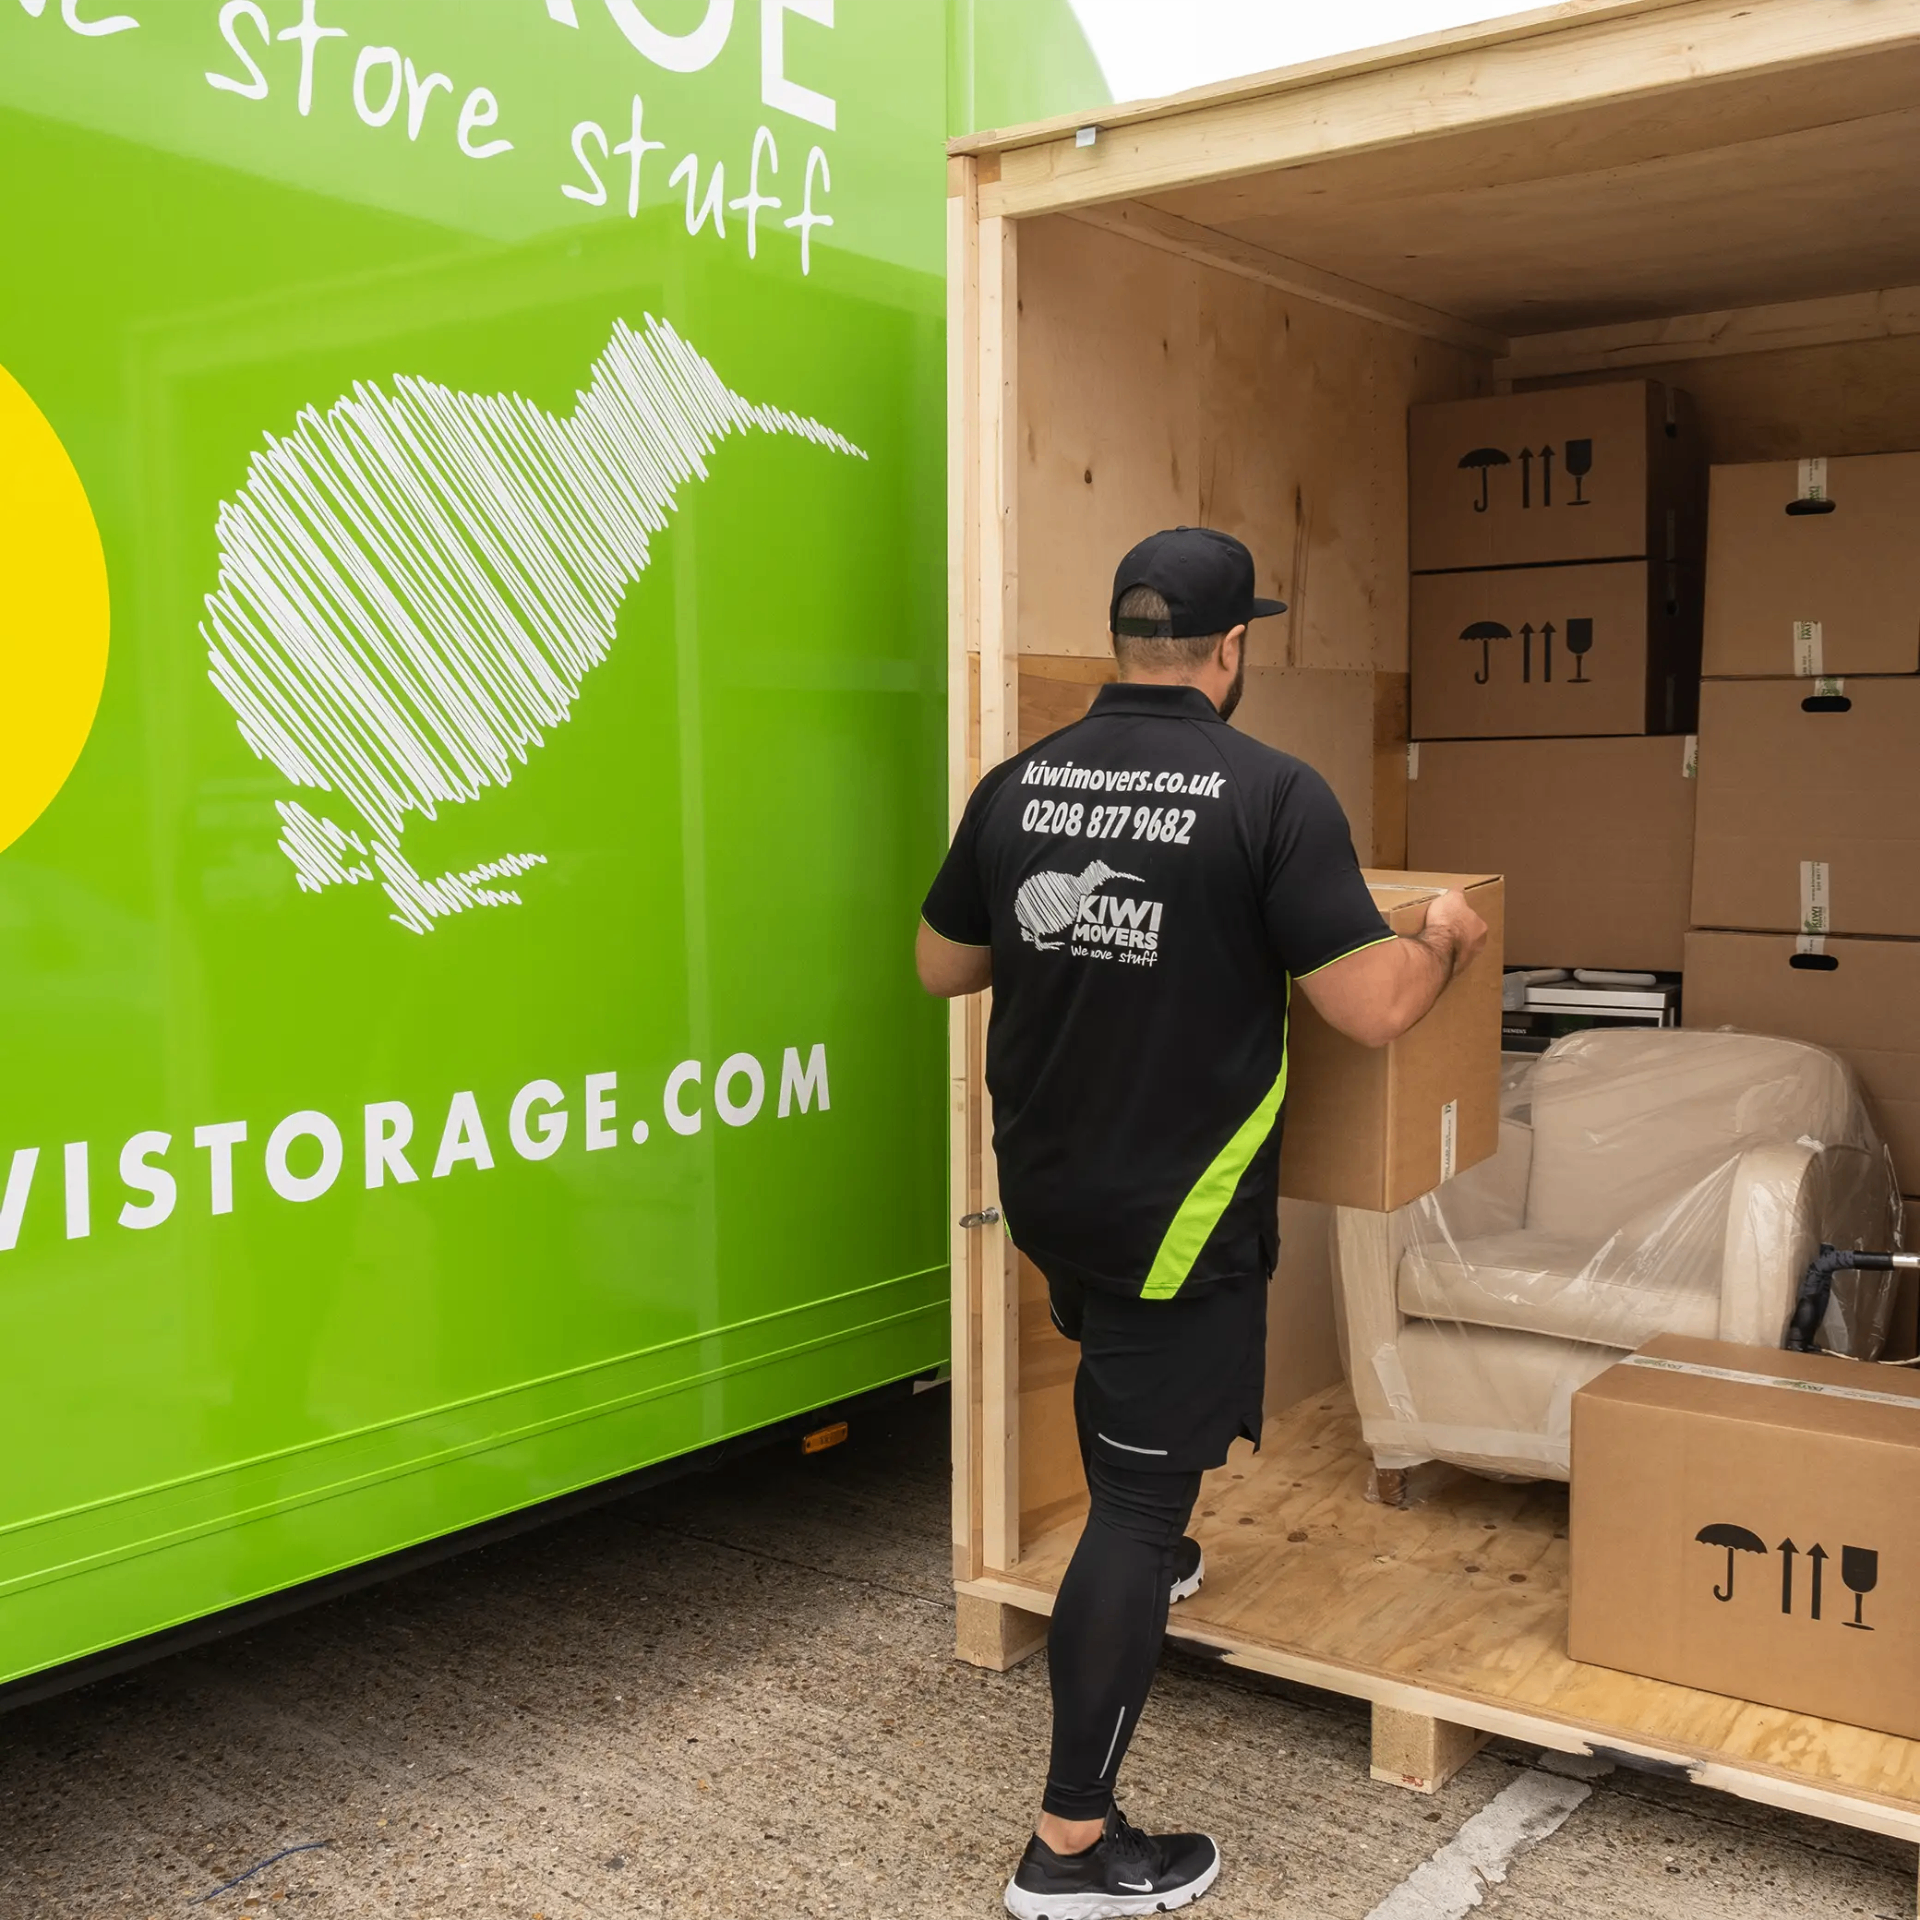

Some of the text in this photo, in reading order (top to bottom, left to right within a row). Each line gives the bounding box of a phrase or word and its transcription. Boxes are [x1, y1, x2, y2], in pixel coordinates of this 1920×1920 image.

[205, 0, 514, 158] store
[561, 94, 835, 276] stuff
[1021, 761, 1227, 798] kiwimovers.co.uk
[1022, 799, 1196, 844] 0208 877 9682
[1076, 895, 1163, 932] KIWI
[1072, 924, 1158, 950] MOVERS
[1071, 945, 1088, 956] We
[1118, 949, 1158, 967] stuff
